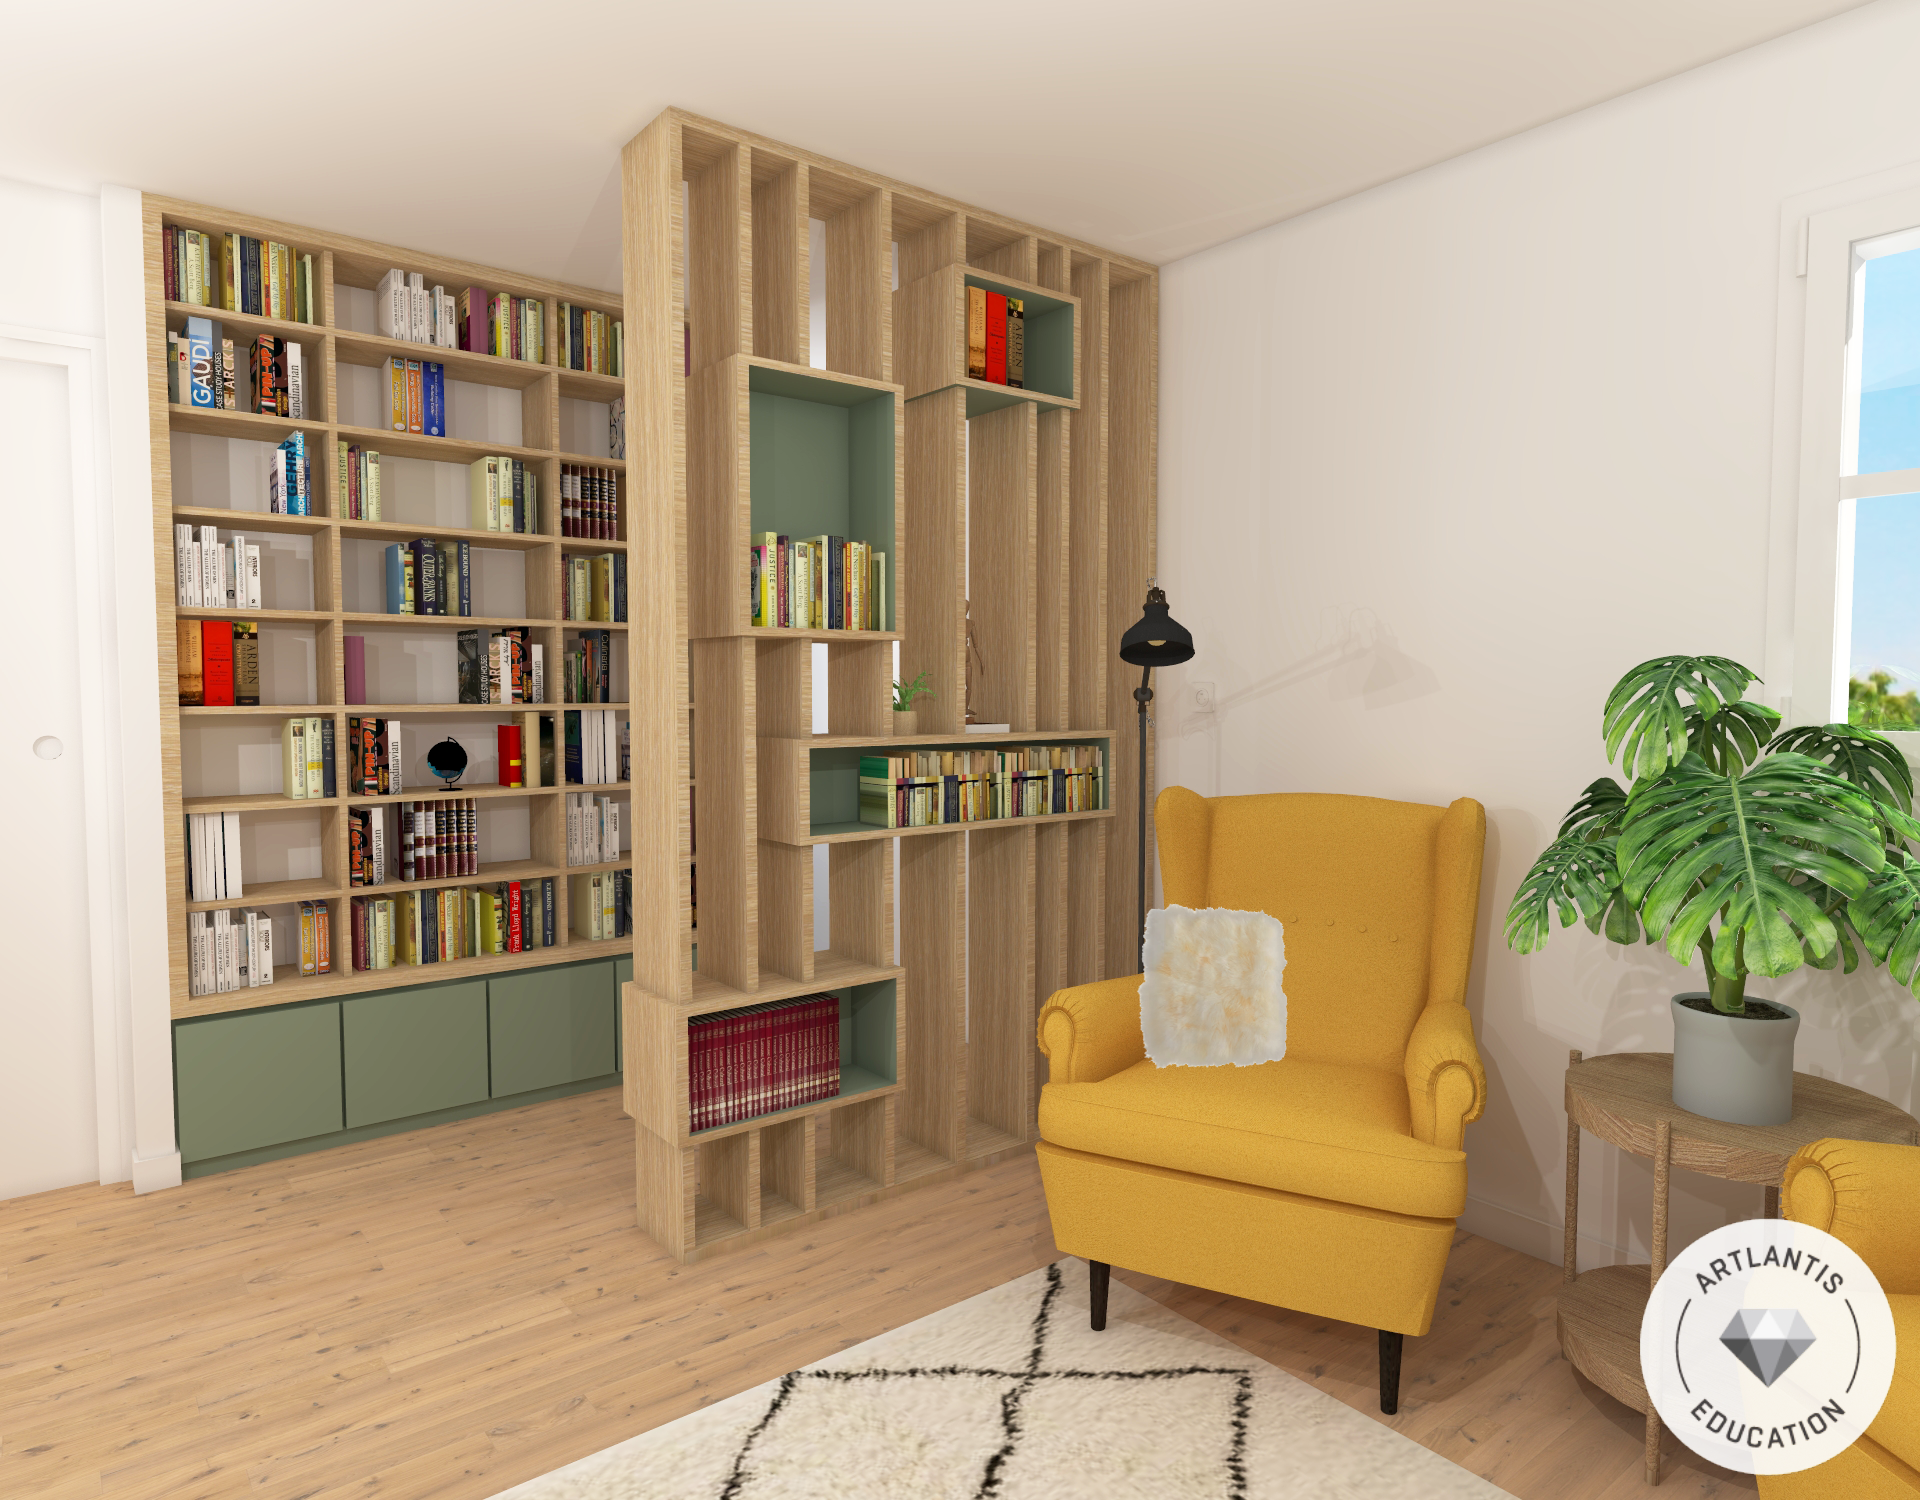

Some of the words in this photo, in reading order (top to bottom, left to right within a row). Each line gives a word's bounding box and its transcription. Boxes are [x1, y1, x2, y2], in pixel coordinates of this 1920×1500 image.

[261, 348, 273, 396] PIN-UP
[286, 441, 297, 496] GEHRY
[247, 644, 258, 684] ARDEN
[512, 643, 520, 684] PIN-UP
[364, 730, 375, 776] PIN-UP
[389, 741, 400, 795] Scandinavian
[352, 831, 361, 869] PIN-UP
[373, 829, 382, 885] Scandinavian
[512, 914, 520, 932] Lloyd
